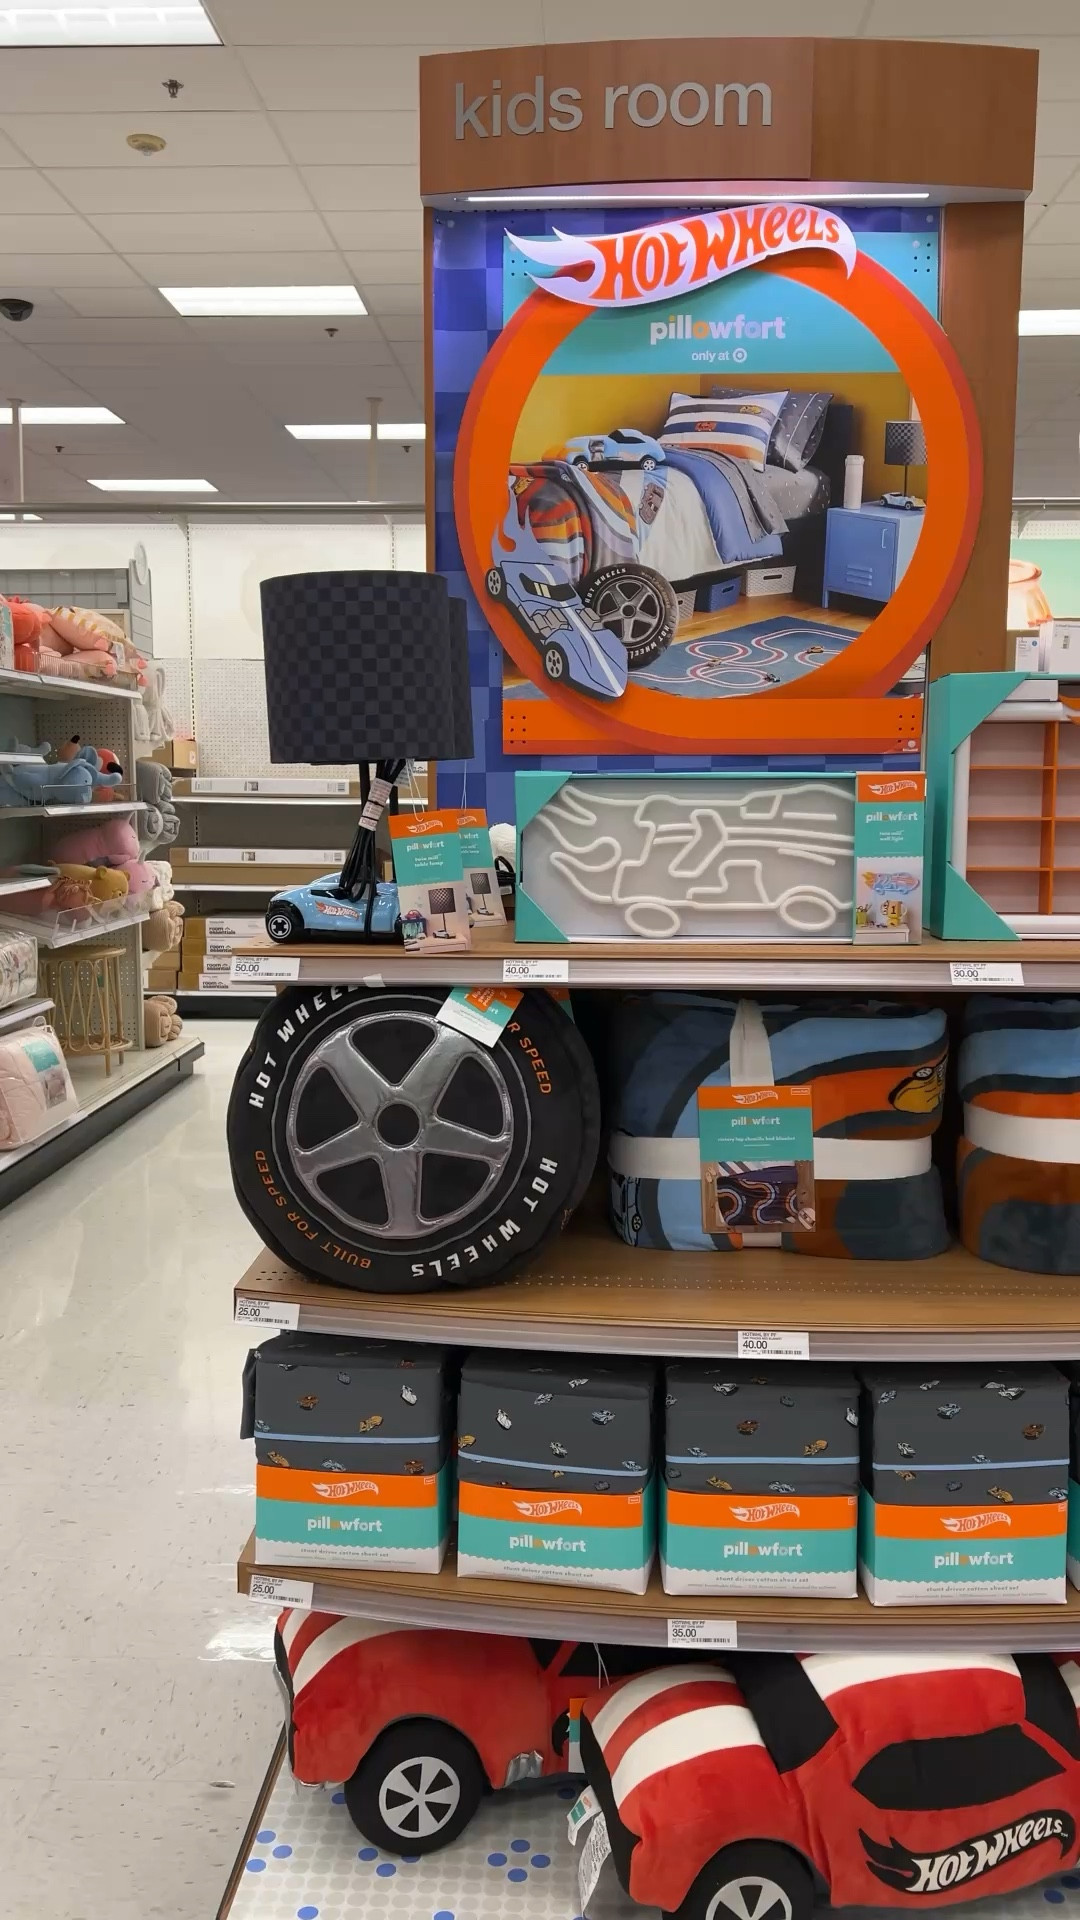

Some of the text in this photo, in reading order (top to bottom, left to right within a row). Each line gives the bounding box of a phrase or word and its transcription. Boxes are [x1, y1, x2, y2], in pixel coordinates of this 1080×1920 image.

[455, 75, 772, 140] kids room
[650, 314, 786, 345] pillowfort
[692, 350, 729, 362] only at
[629, 641, 657, 660] WHEEL
[866, 811, 917, 823] pillowfort
[406, 841, 444, 852] pillowfort
[235, 964, 259, 972] 50.00
[505, 966, 530, 974] 40.00
[953, 970, 979, 978] 30.00
[519, 1037, 552, 1094] SPEED
[249, 1052, 276, 1108] HOT
[731, 1116, 780, 1127] pillowfort
[523, 1157, 558, 1212] HOT
[254, 1150, 372, 1269] BUILT FOR SPEED
[411, 1219, 521, 1278] WHEELS
[238, 1307, 260, 1316] 25.00
[743, 1340, 768, 1349] 40.00
[308, 1516, 382, 1532] pillowfort
[509, 1534, 586, 1552] pillowfort
[723, 1542, 802, 1558] pillowfort
[935, 1551, 1014, 1568] pillowfort
[253, 1584, 274, 1594] 25.00
[672, 1629, 697, 1637] 35.00
